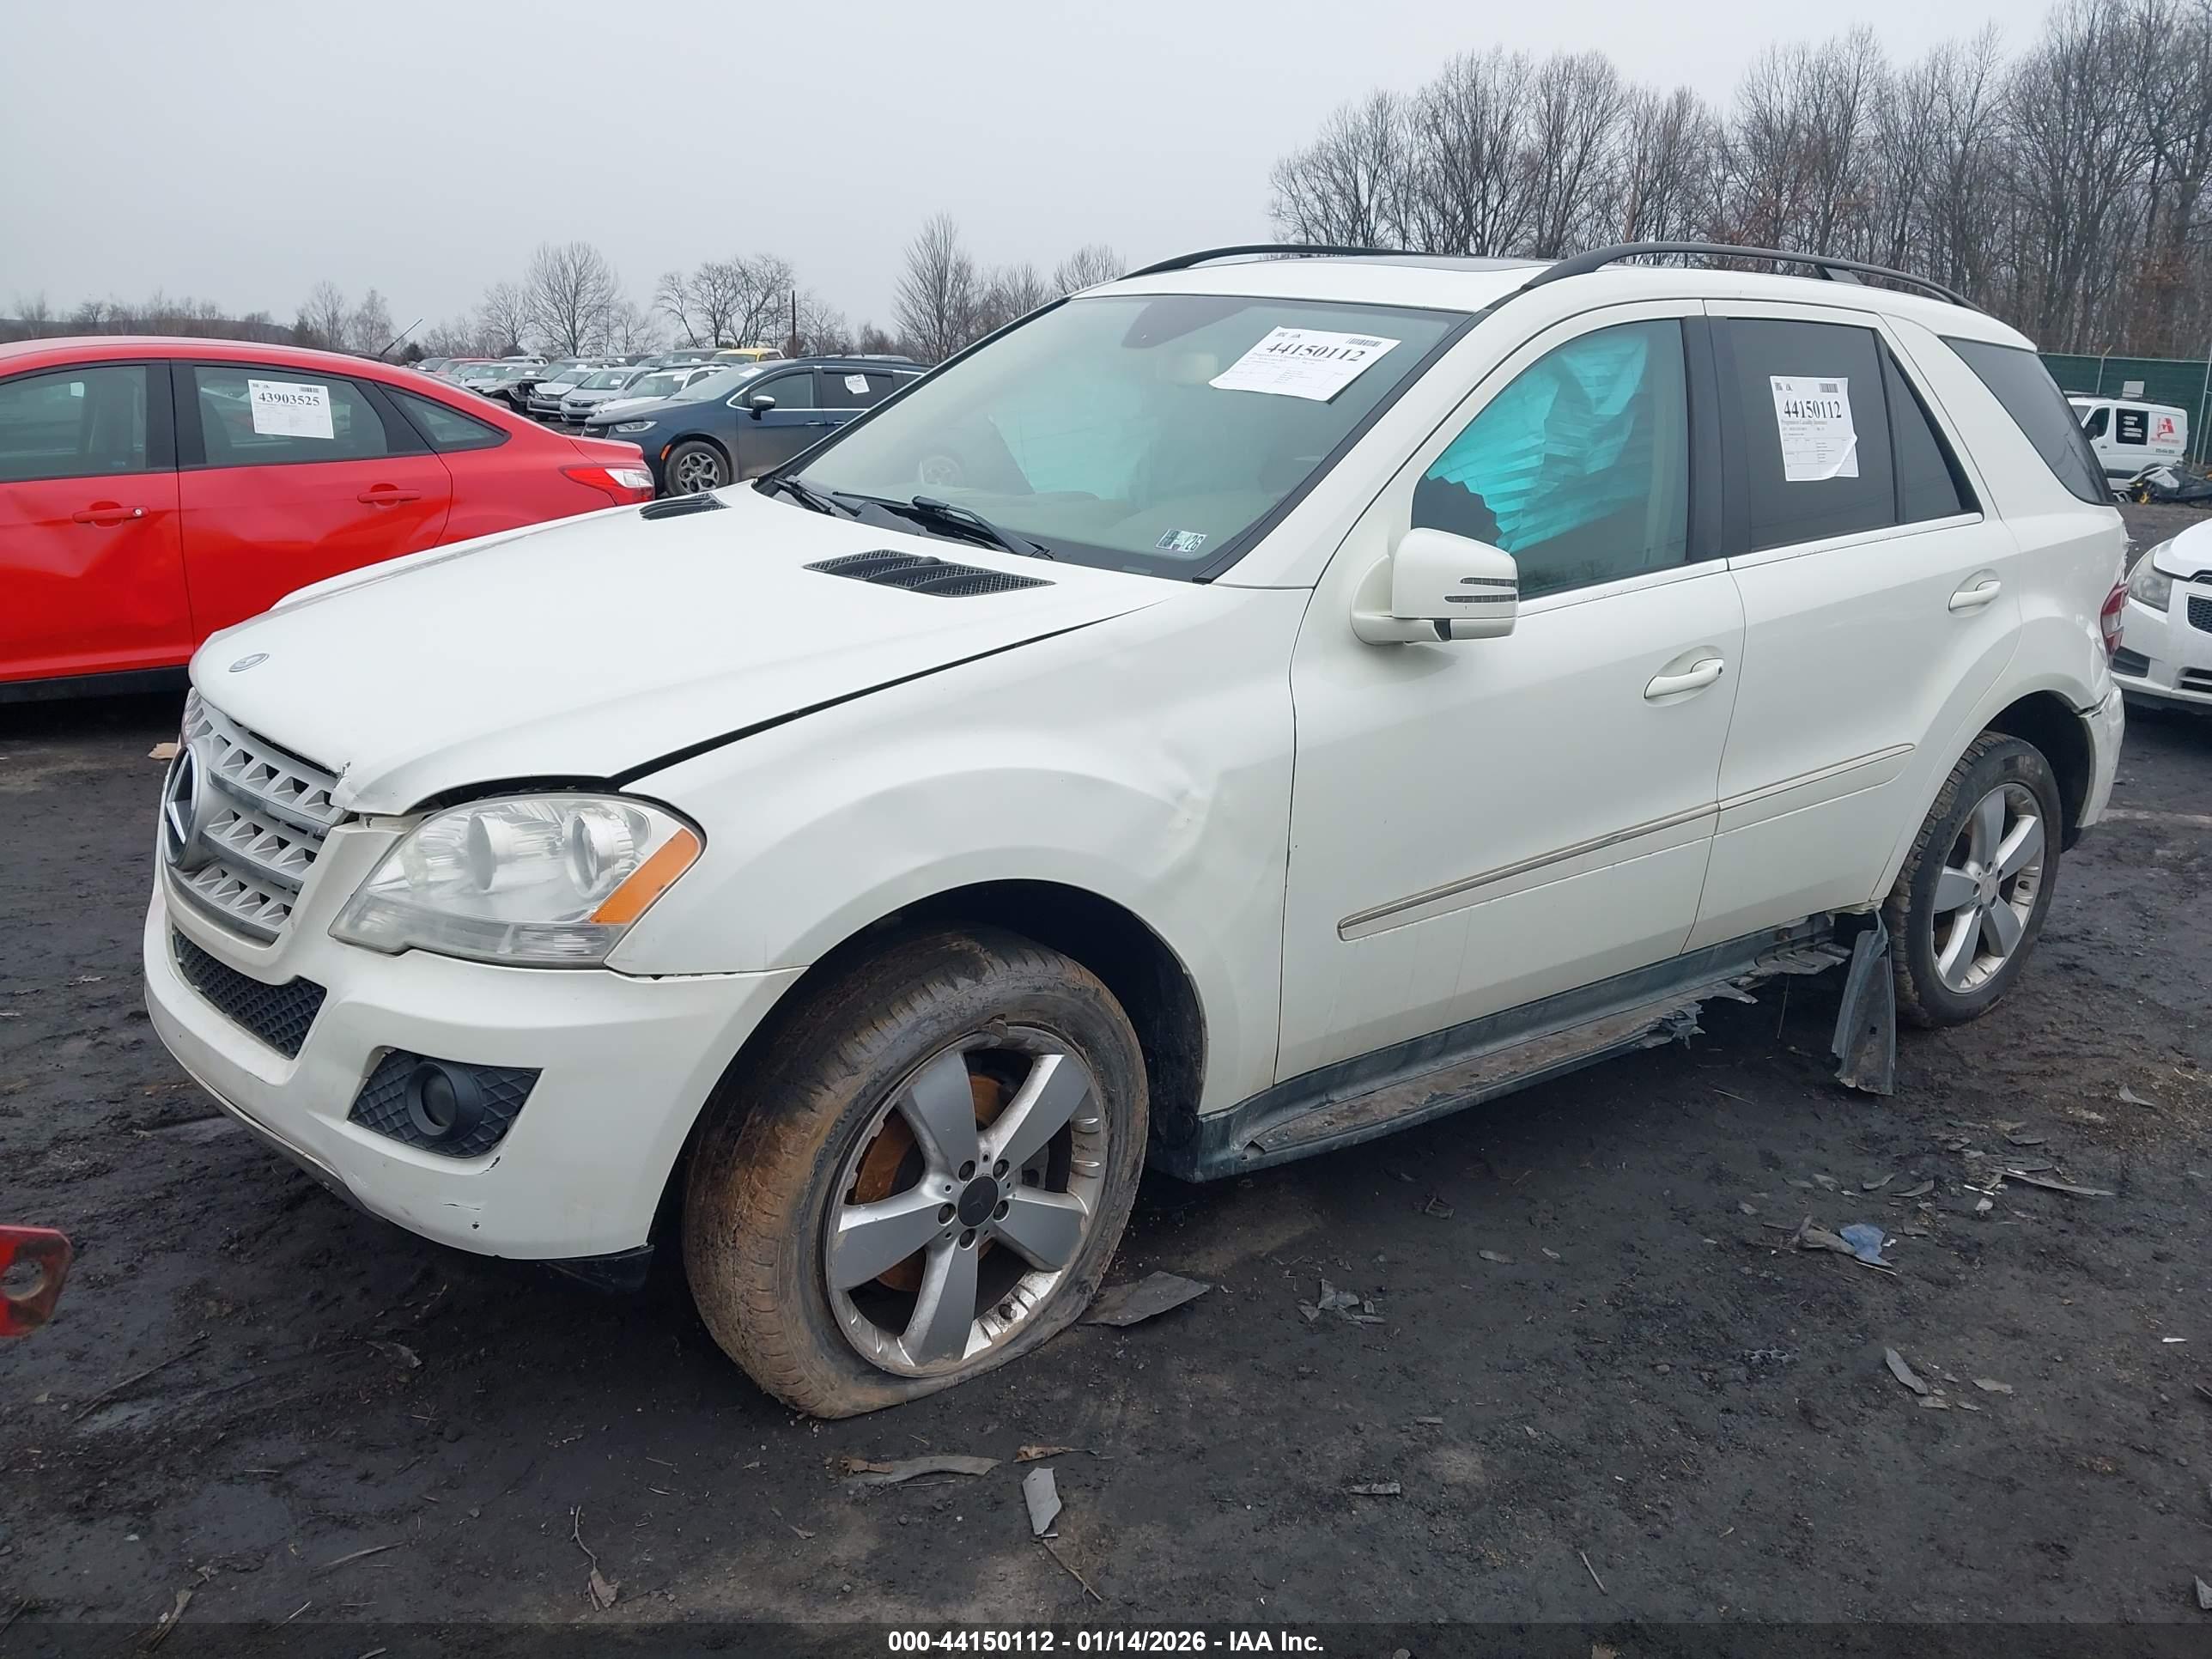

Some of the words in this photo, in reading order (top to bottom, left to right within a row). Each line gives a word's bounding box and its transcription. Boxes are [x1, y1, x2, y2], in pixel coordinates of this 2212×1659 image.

[1266, 342, 1366, 362] 44150112
[258, 392, 320, 406] 43903525
[1784, 399, 1842, 419] 44150112
